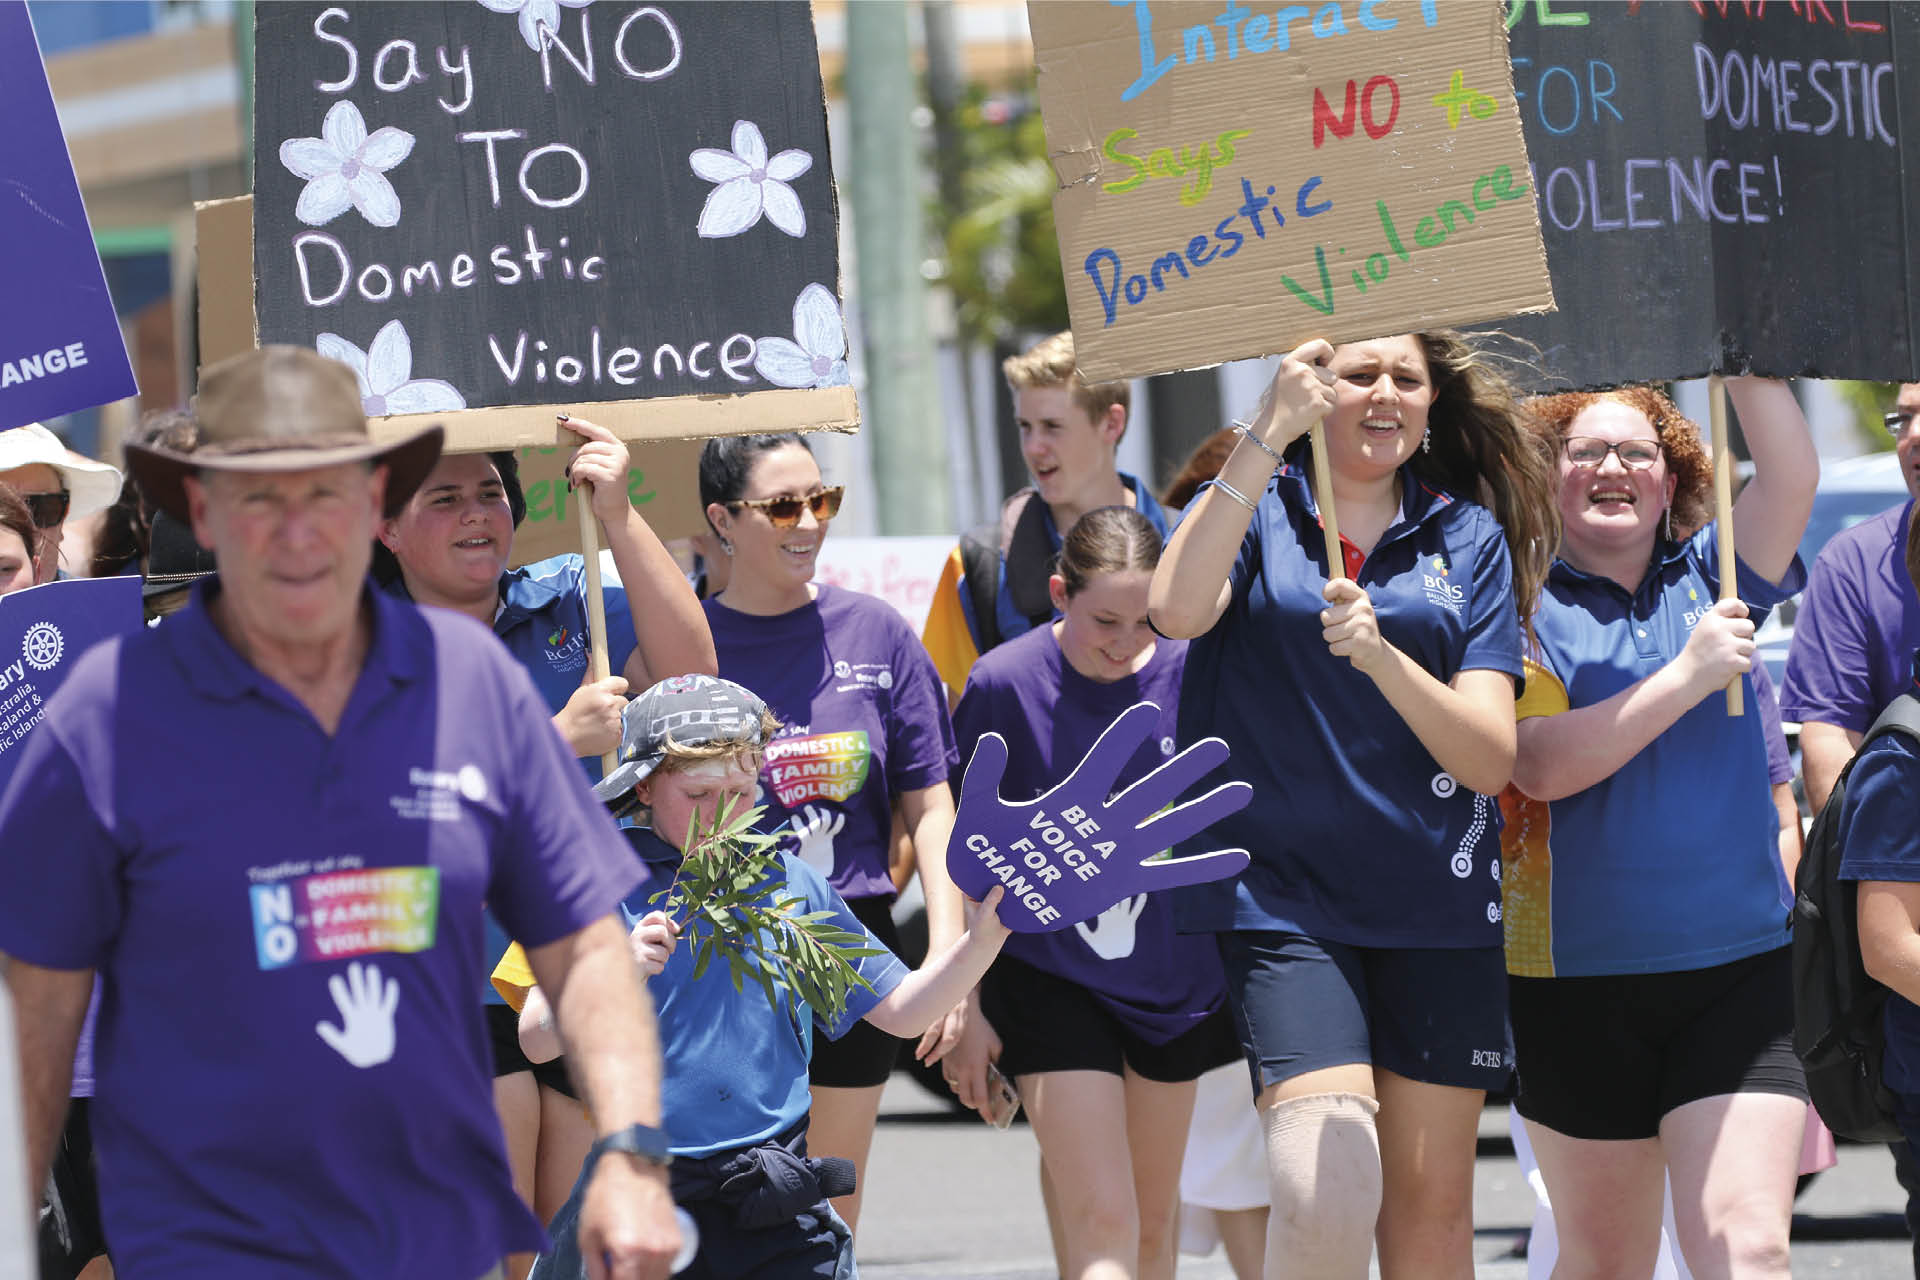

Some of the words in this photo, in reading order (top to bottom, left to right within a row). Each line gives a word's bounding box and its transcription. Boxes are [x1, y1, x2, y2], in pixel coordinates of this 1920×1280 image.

[312, 6, 473, 115] Say
[536, 7, 684, 92] NO
[1693, 42, 1897, 146] DOMESTIC
[1103, 127, 1254, 206] Says
[1313, 75, 1401, 149] NO
[1432, 69, 1498, 130] to
[457, 129, 589, 208] TO
[291, 225, 606, 307] Domestic
[1084, 175, 1334, 328] Domestic
[1280, 164, 1529, 315] Violence
[0, 341, 88, 389] ANGE
[487, 325, 758, 385] Violence
[0, 659, 25, 691] ary
[0, 683, 37, 717] stralia,
[32, 693, 43, 706] &
[771, 759, 865, 785] FAMILY
[777, 779, 859, 805] VIOLENE
[1009, 837, 1062, 887] FOR
[1029, 810, 1101, 882] VOICE
[1060, 804, 1101, 839] BE
[1091, 840, 1117, 860] A
[966, 834, 1061, 926] CHANGE
[1471, 1049, 1501, 1068] BCHS
